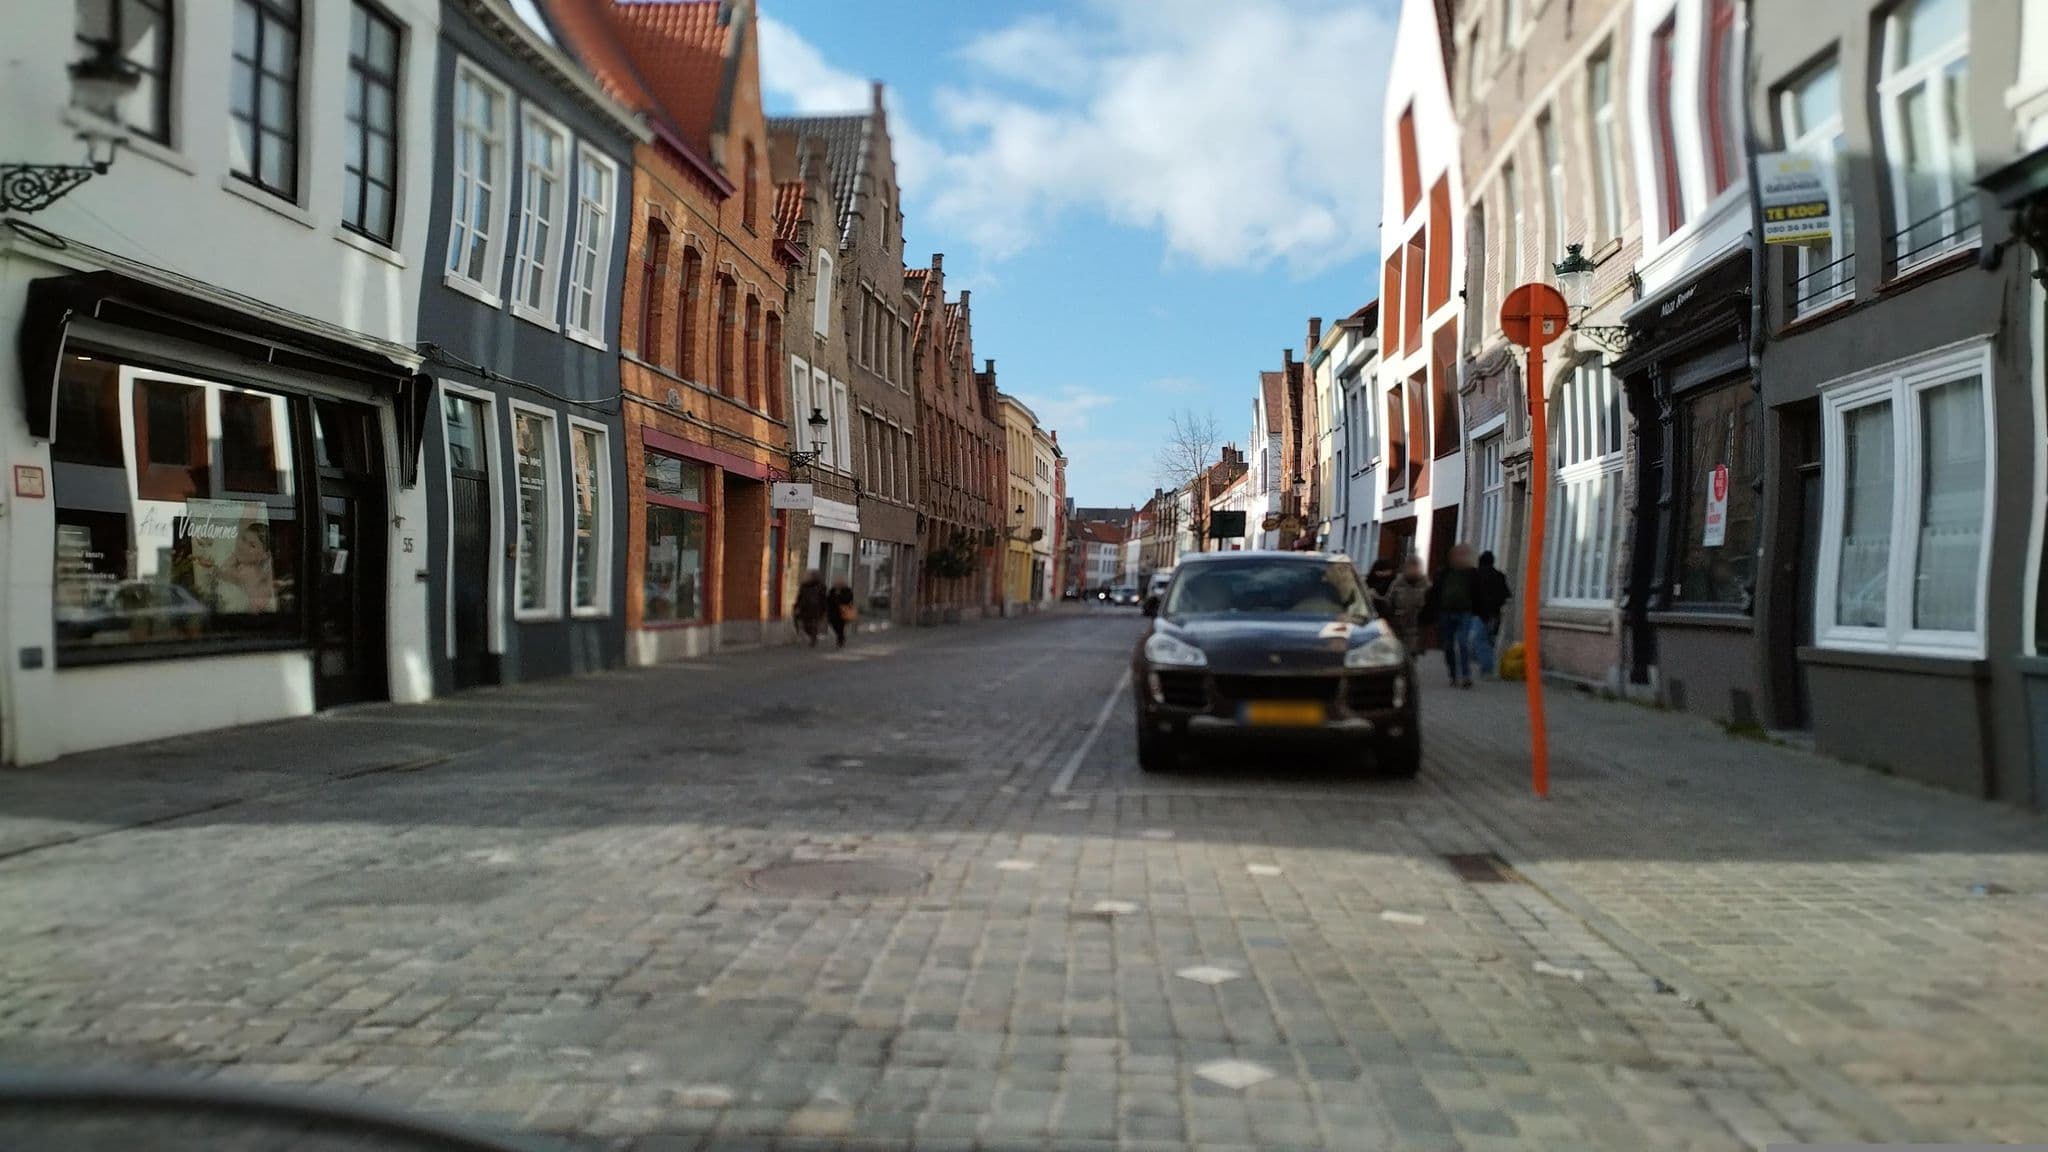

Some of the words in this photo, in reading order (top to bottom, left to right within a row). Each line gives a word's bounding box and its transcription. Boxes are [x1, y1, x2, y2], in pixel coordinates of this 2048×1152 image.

[1767, 207, 1785, 221] TE
[179, 509, 239, 540] Vandamme
[403, 537, 413, 553] 55
